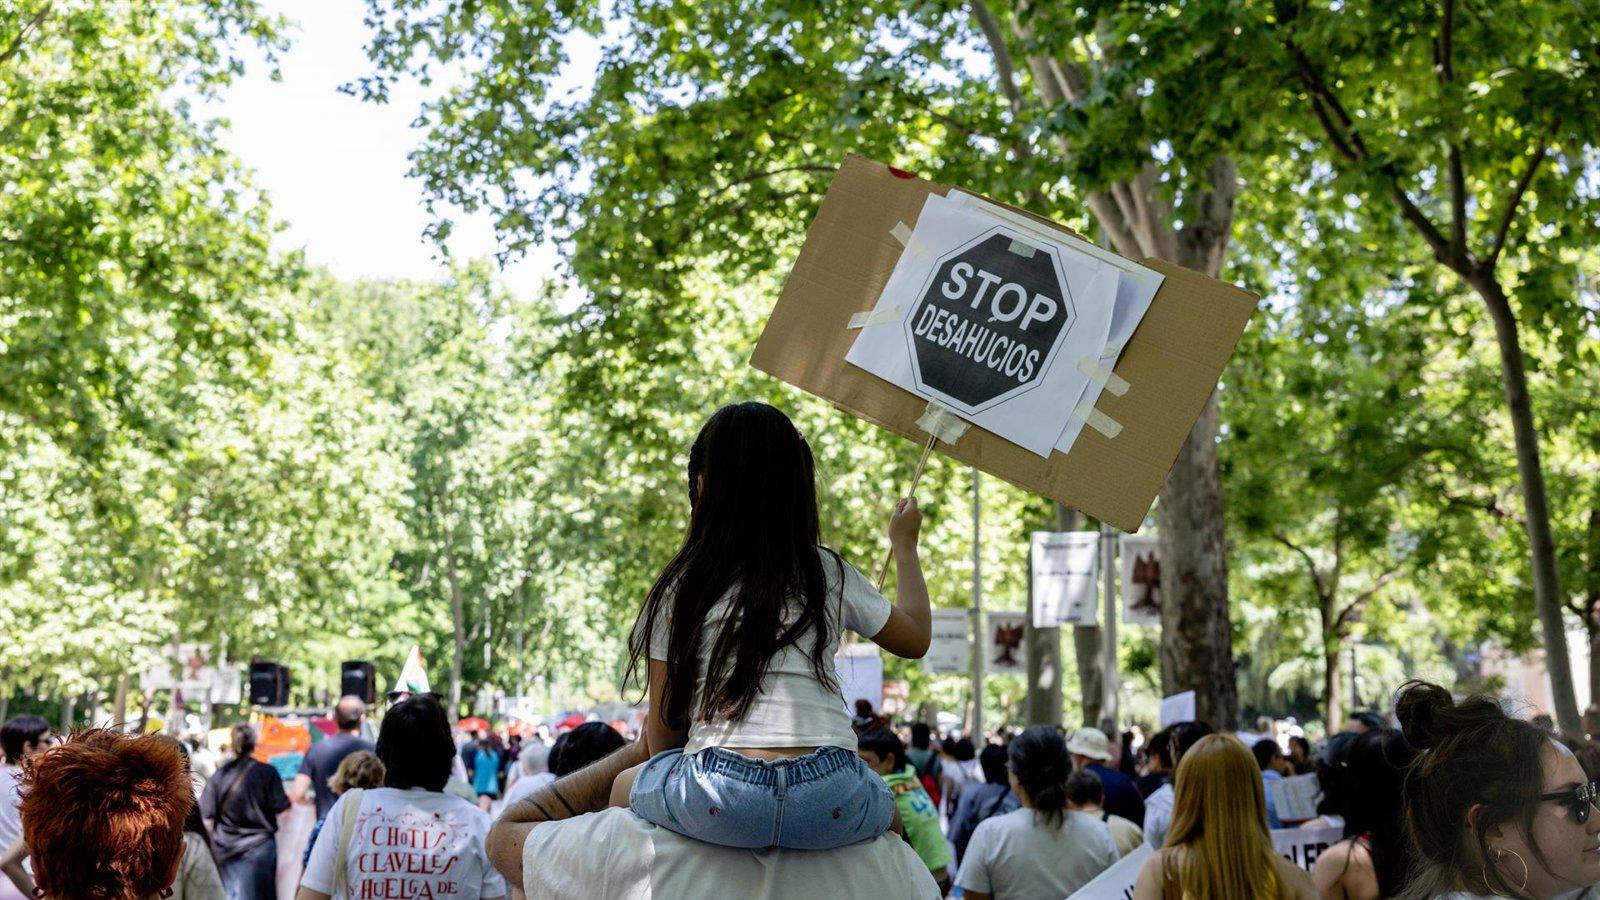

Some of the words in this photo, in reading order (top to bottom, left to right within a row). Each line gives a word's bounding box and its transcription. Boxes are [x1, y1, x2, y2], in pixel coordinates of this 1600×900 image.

[941, 261, 1058, 331] STOP
[359, 852, 458, 875] CLAVELES
[360, 878, 434, 900] HUELGA
[437, 881, 458, 894] DE
